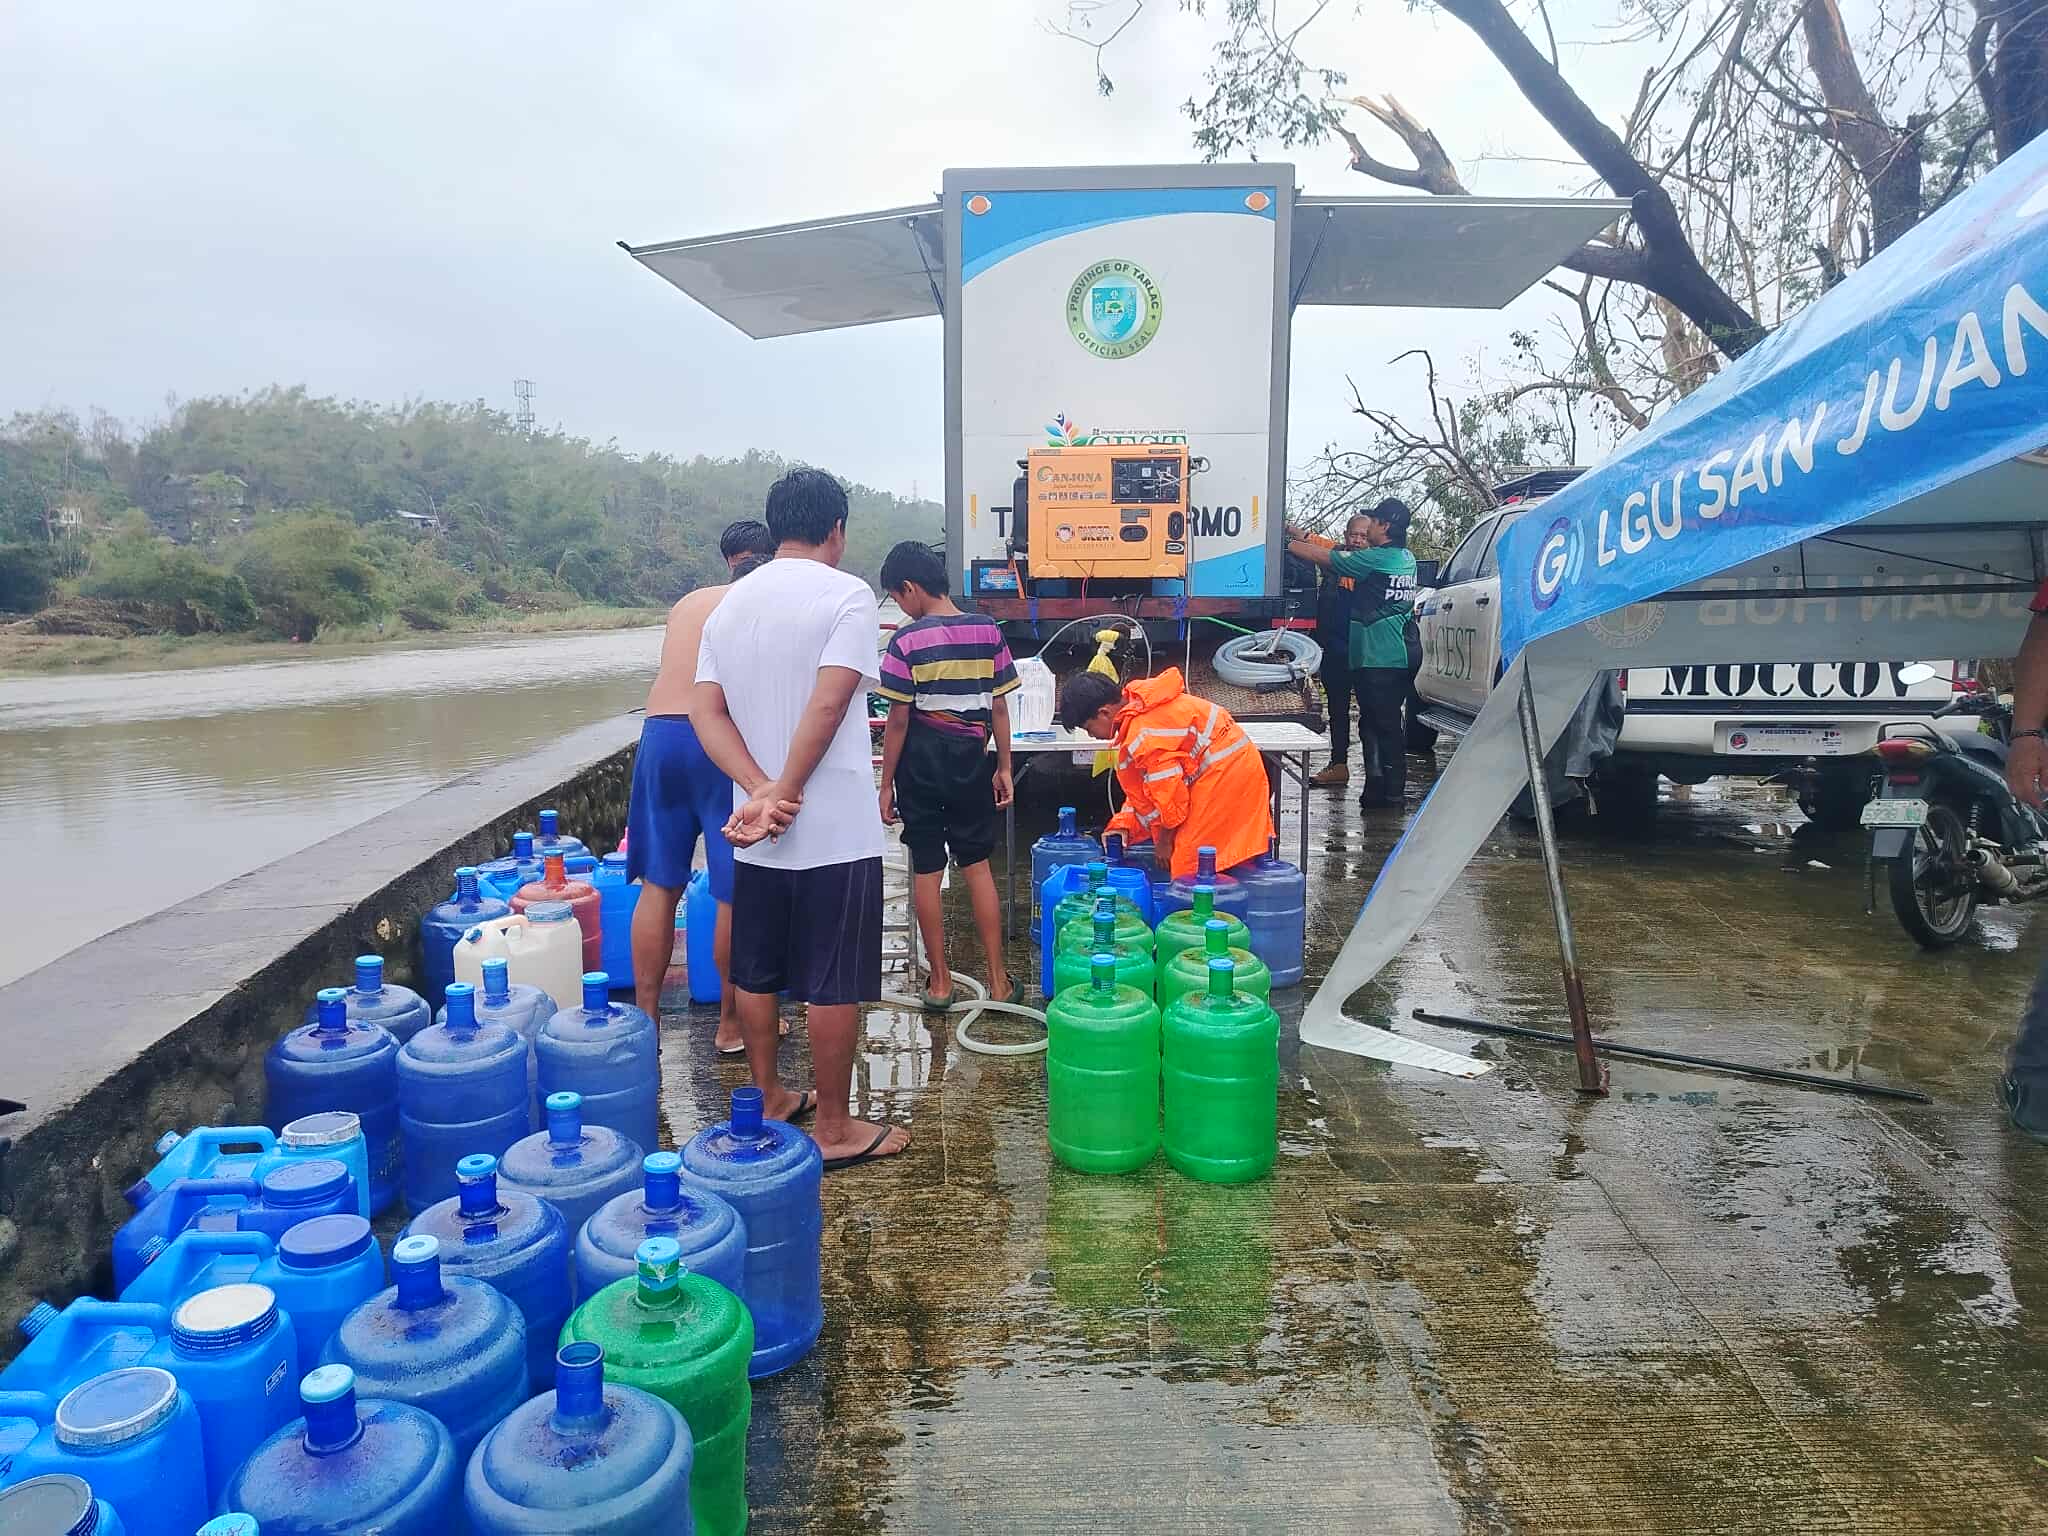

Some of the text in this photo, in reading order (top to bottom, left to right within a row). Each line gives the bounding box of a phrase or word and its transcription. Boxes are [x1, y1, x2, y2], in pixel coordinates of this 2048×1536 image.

[1070, 263, 1159, 311] PROVINCE OF TARLAC
[1078, 331, 1152, 356] OFFICIAL SEAL
[1597, 283, 2048, 567] LGU SAN JUAN
[1436, 625, 1477, 680] CEST
